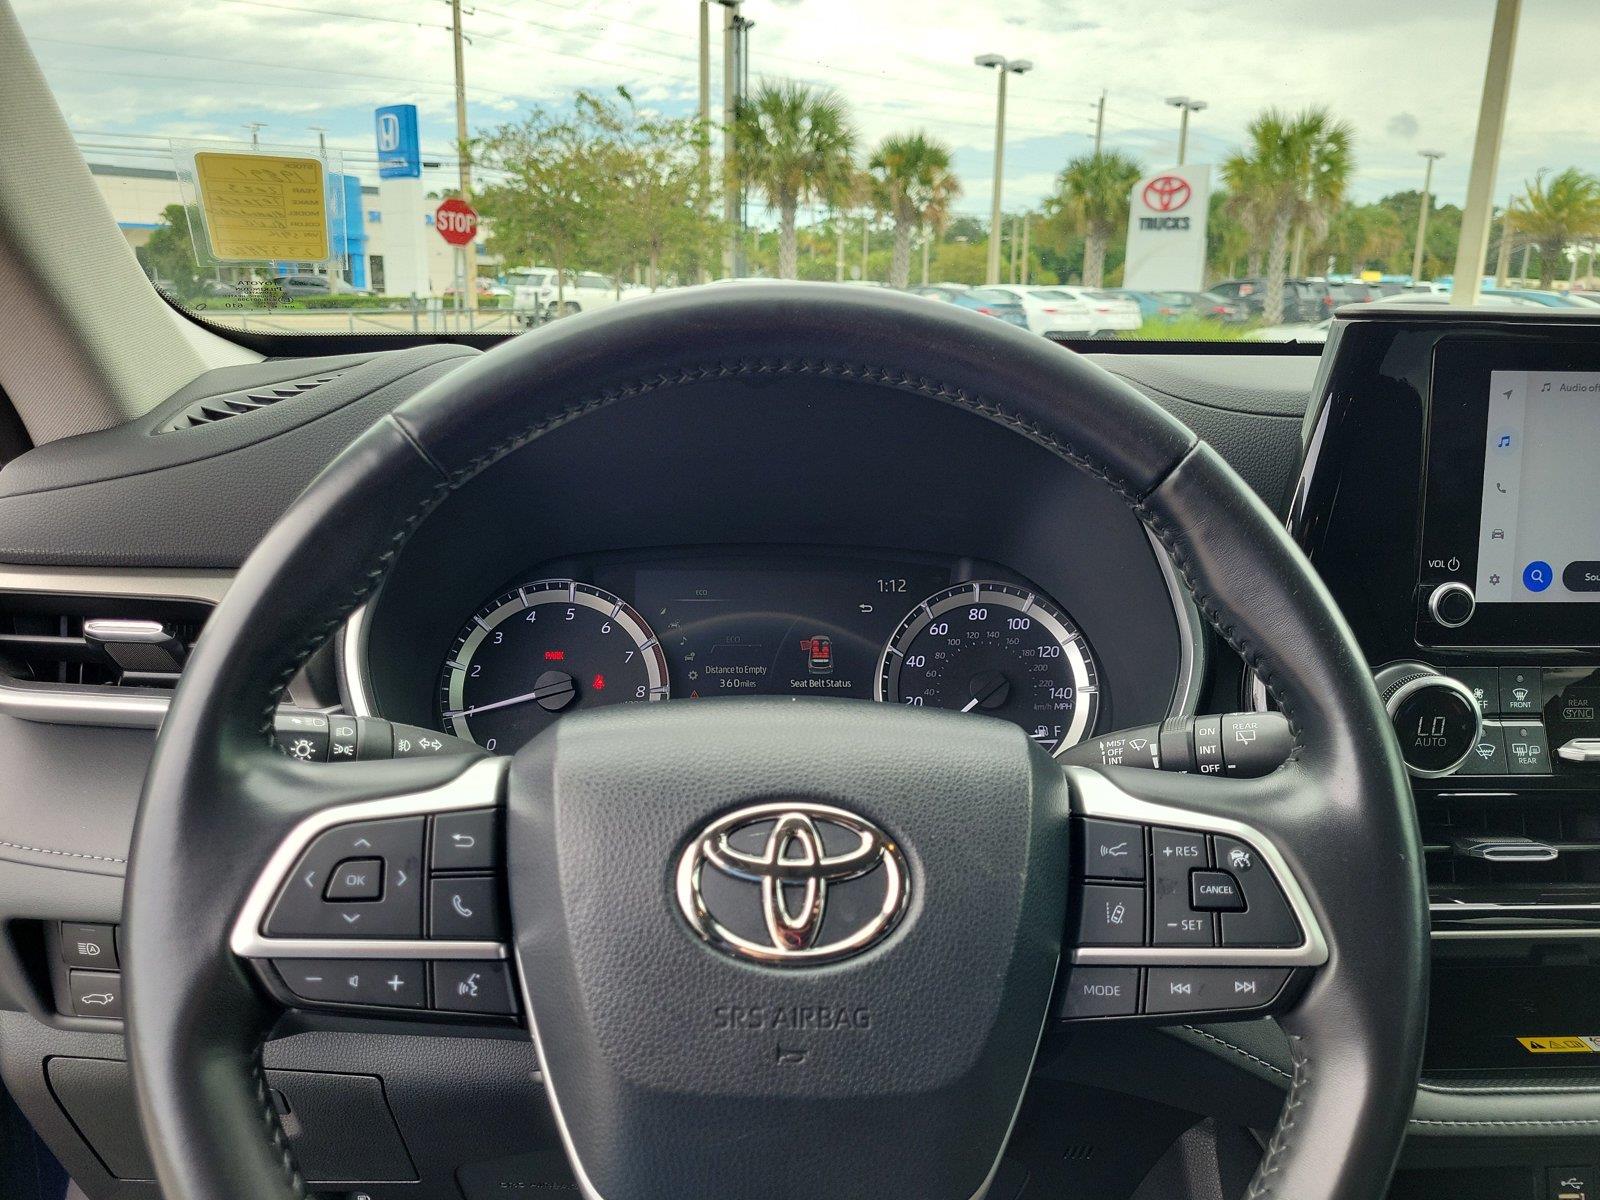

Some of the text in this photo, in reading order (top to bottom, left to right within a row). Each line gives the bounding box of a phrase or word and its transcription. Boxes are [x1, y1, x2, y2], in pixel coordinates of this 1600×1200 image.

[436, 211, 477, 233] STOP
[1139, 217, 1190, 231] TRUCKS
[1560, 383, 1587, 392] Audio
[1429, 560, 1445, 568] VOL
[877, 579, 907, 593] 1:12
[525, 611, 537, 623] 4
[565, 608, 576, 621] 5
[968, 608, 988, 621] 80
[601, 622, 611, 634] 6
[929, 623, 948, 635] 60
[1006, 618, 1030, 630] 100
[493, 632, 503, 644] 3
[966, 631, 980, 639] 120
[986, 630, 999, 639] 140
[947, 638, 961, 646] 100
[1005, 637, 1020, 645] 160
[934, 652, 946, 660] 80
[1037, 646, 1060, 658] 120
[624, 651, 634, 664] 7
[906, 656, 925, 668] 40
[471, 665, 481, 677] 2
[705, 665, 767, 676] Distance to Empty
[925, 670, 937, 678] 60
[719, 679, 756, 688] 360 miles
[790, 679, 851, 688] Seat Belt Status
[636, 686, 646, 698] 8
[924, 688, 935, 696] 40
[1049, 687, 1073, 699] 140
[905, 696, 924, 706] 20
[1054, 702, 1073, 711] MPH
[1566, 709, 1592, 718] SYNC
[1054, 726, 1061, 736] F
[1199, 728, 1216, 736] ON
[486, 739, 497, 750] 0
[1107, 739, 1126, 747] MIST
[1415, 738, 1447, 747] AUTO
[1107, 748, 1124, 757] OFF
[1200, 745, 1216, 755] INT
[1108, 757, 1123, 765] INT
[1200, 764, 1220, 773] OFF
[346, 875, 366, 885] OK
[1200, 885, 1233, 894] CANCEL
[1084, 985, 1121, 996] MODE
[715, 1006, 872, 1030] SRS AIRBAG
